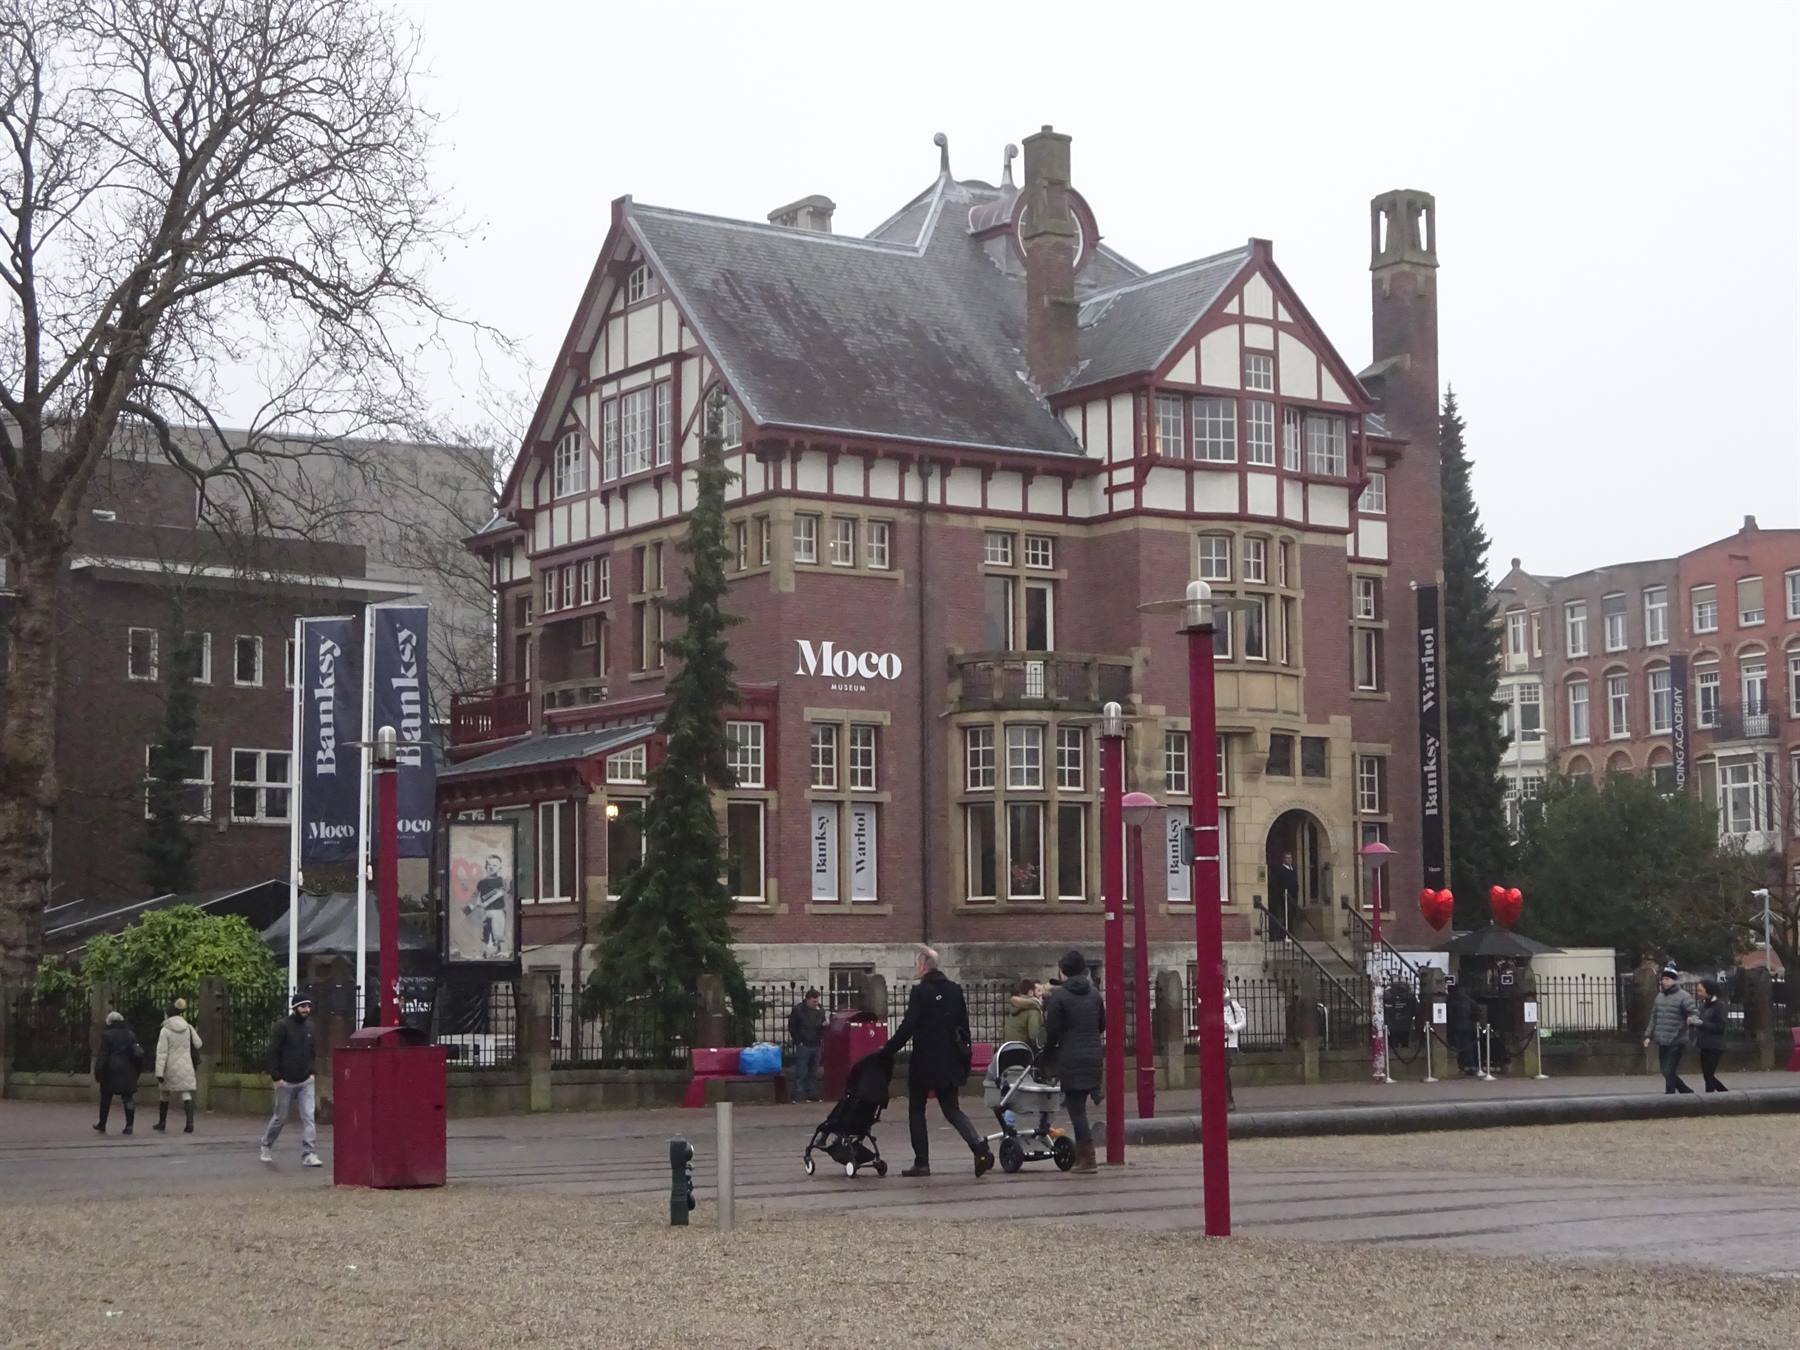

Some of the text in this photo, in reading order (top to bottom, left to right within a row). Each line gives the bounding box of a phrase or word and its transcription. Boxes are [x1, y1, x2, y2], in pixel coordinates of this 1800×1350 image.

[794, 639, 903, 680] Moco
[831, 683, 866, 692] MUSEUM
[314, 635, 341, 776] Banksy
[391, 623, 422, 768] Banksy
[1421, 627, 1440, 816] Banksy Warhol
[1673, 687, 1686, 792] NDING ACADEMY
[308, 821, 355, 839] Moco
[396, 819, 432, 833] oco
[815, 815, 829, 873] Banksy
[854, 812, 866, 874] Warhol
[1168, 819, 1181, 874] Banksy
